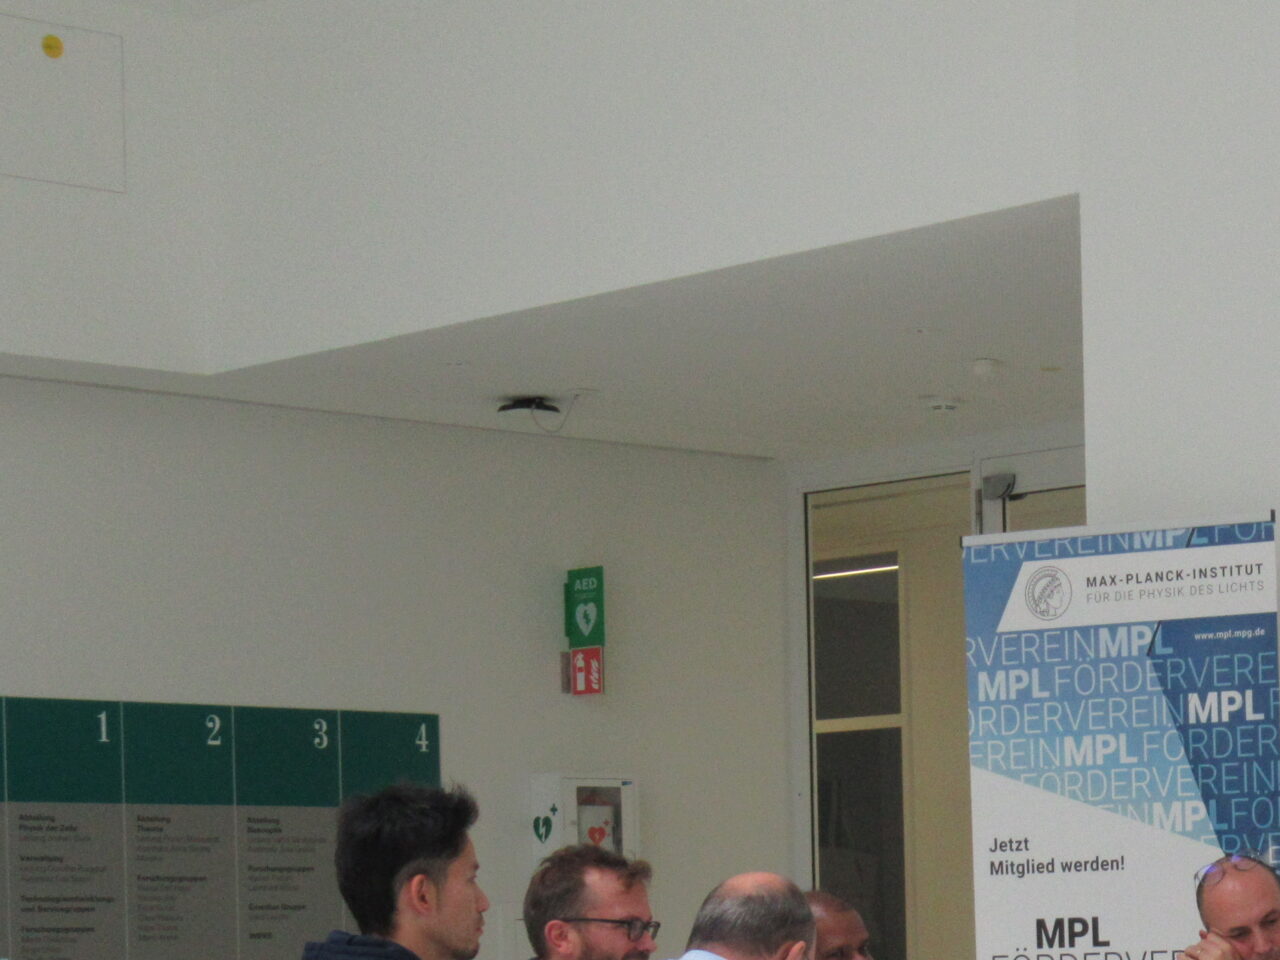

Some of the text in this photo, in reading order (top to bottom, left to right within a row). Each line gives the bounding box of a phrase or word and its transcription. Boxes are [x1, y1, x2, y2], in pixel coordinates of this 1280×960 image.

[574, 577, 598, 591] AED
[1086, 563, 1264, 588] MAX-PLANCK-INSTITUT
[1086, 580, 1265, 604] FÜR DIE PHYSIK DES LICHTS
[1194, 628, 1266, 641] www.mpl.mpg.de
[96, 711, 111, 743] 1
[205, 714, 222, 746] 2
[313, 719, 328, 749] 3
[415, 724, 429, 752] 4
[989, 837, 1030, 853] Jetzt
[990, 855, 1125, 878] Mitglied werden!
[1036, 916, 1110, 949] MPL
